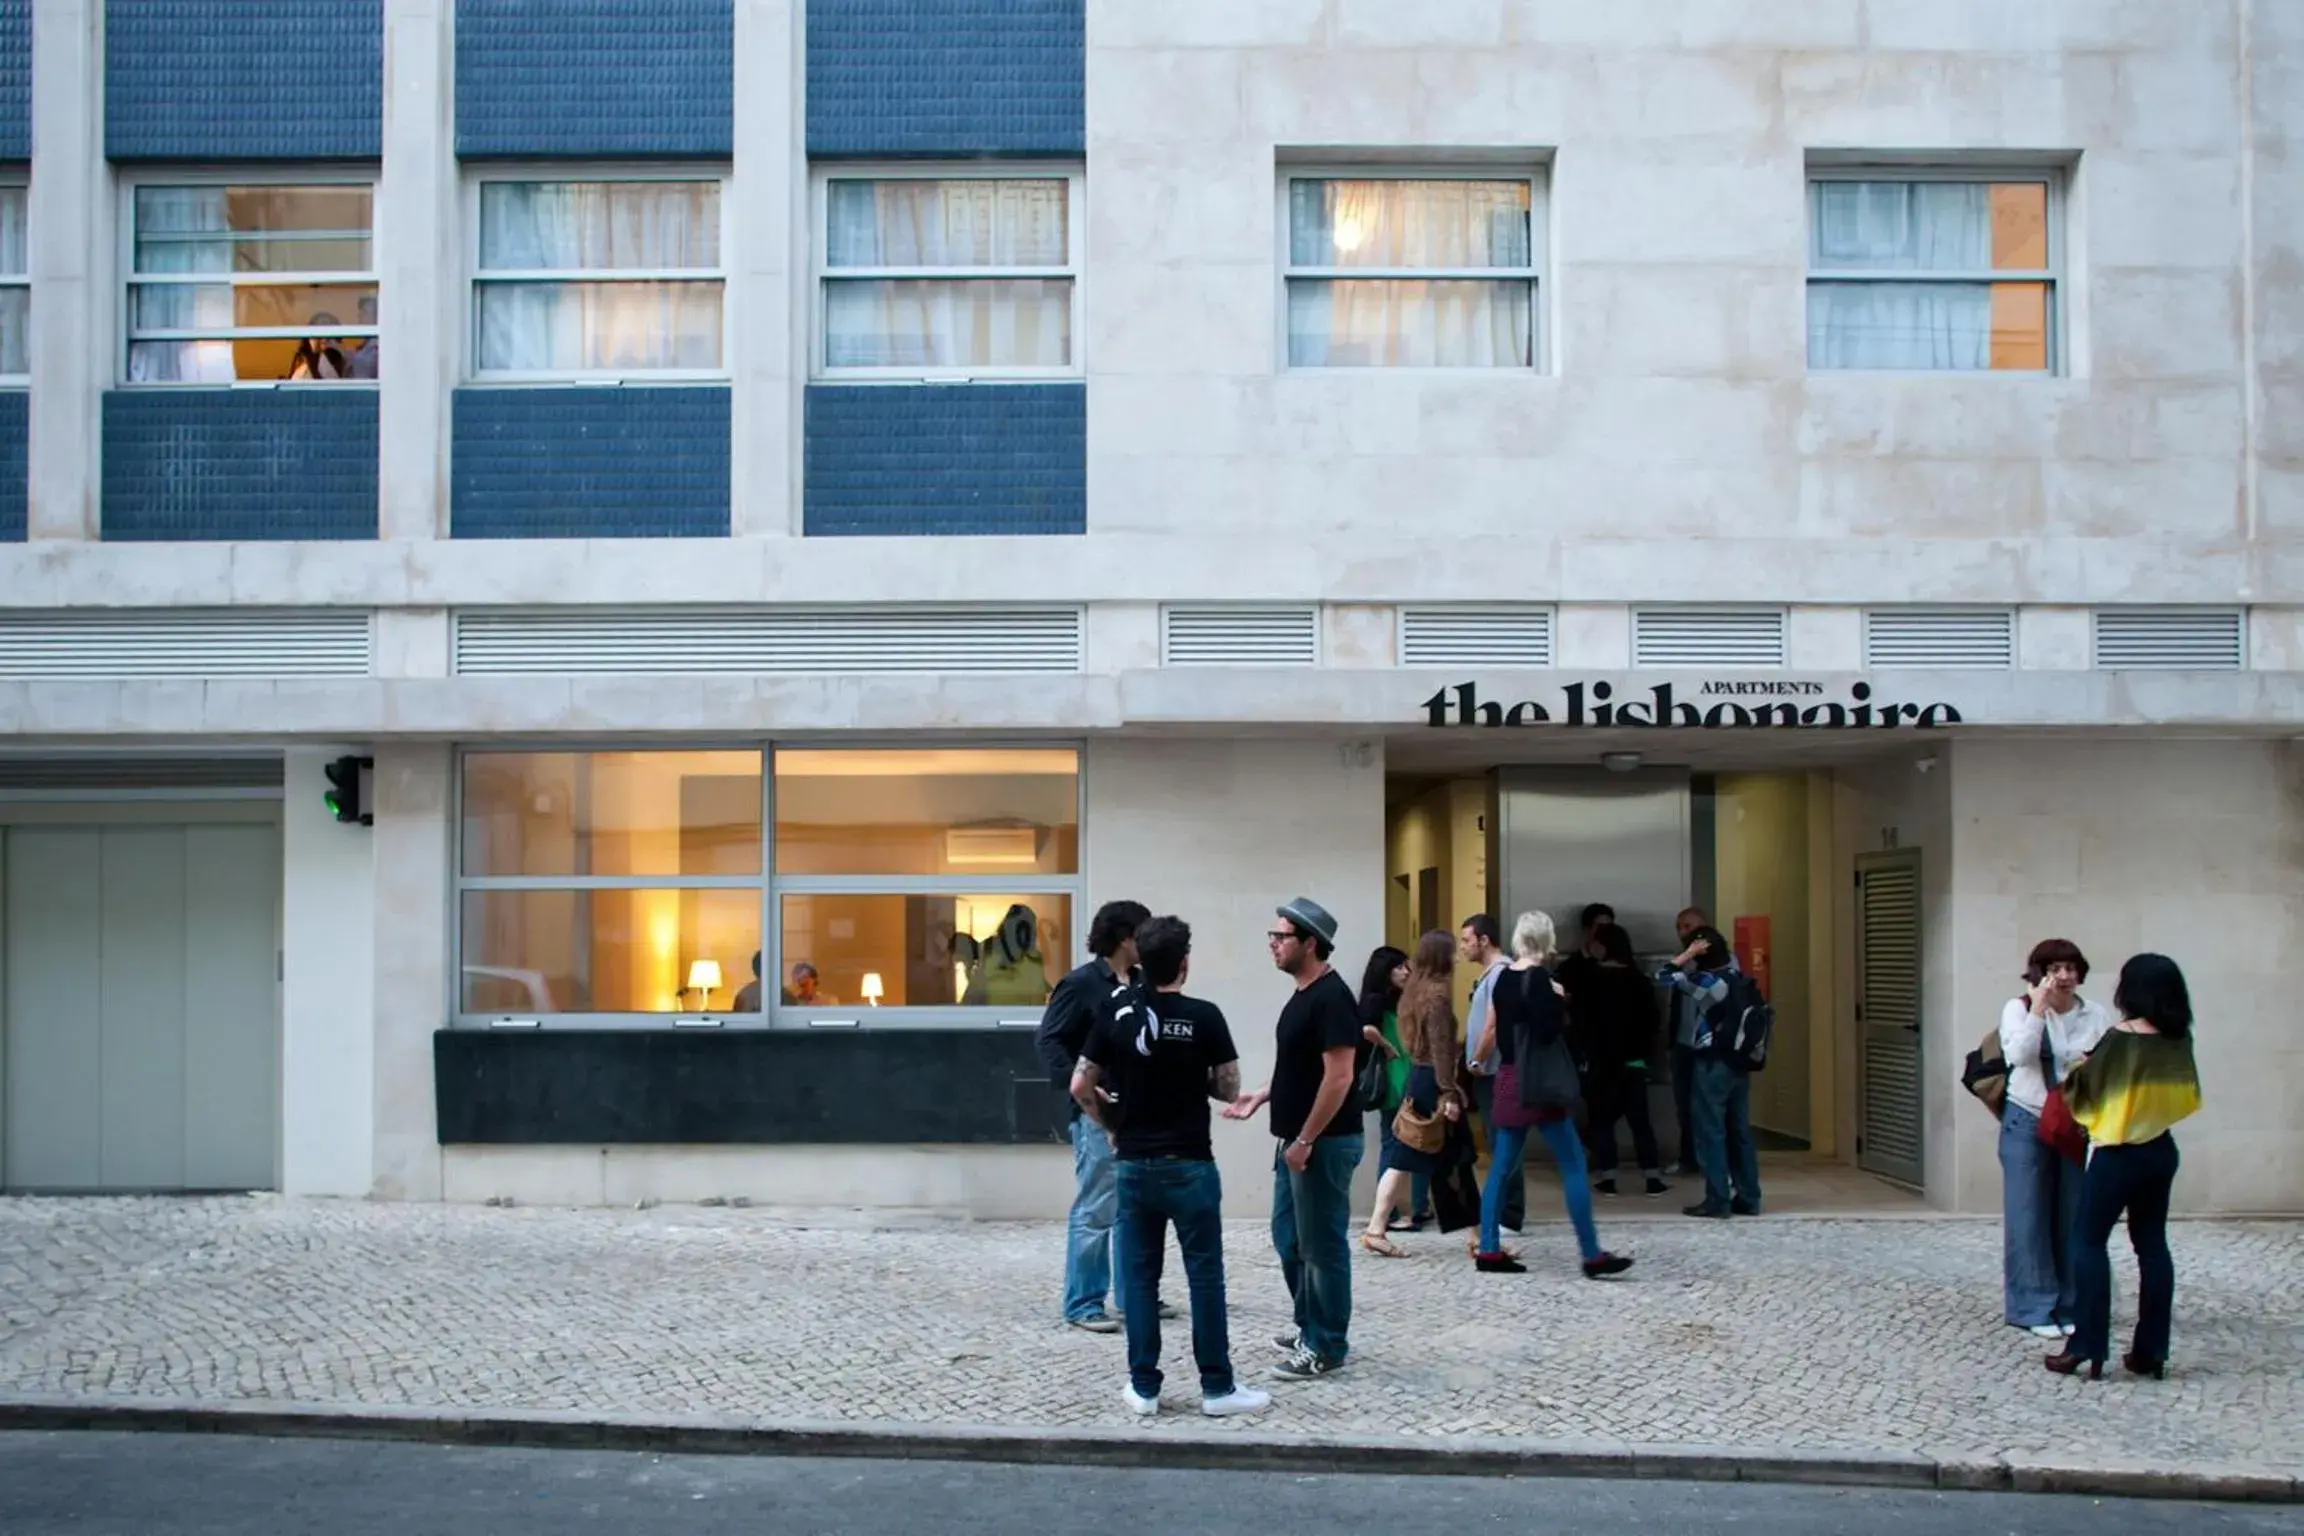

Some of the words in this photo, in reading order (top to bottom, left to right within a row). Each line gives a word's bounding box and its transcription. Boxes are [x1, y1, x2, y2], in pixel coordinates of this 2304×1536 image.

[1700, 681, 1824, 695] APARTMENTS
[1420, 681, 1550, 727] the
[1561, 680, 1962, 728] lisbonaire
